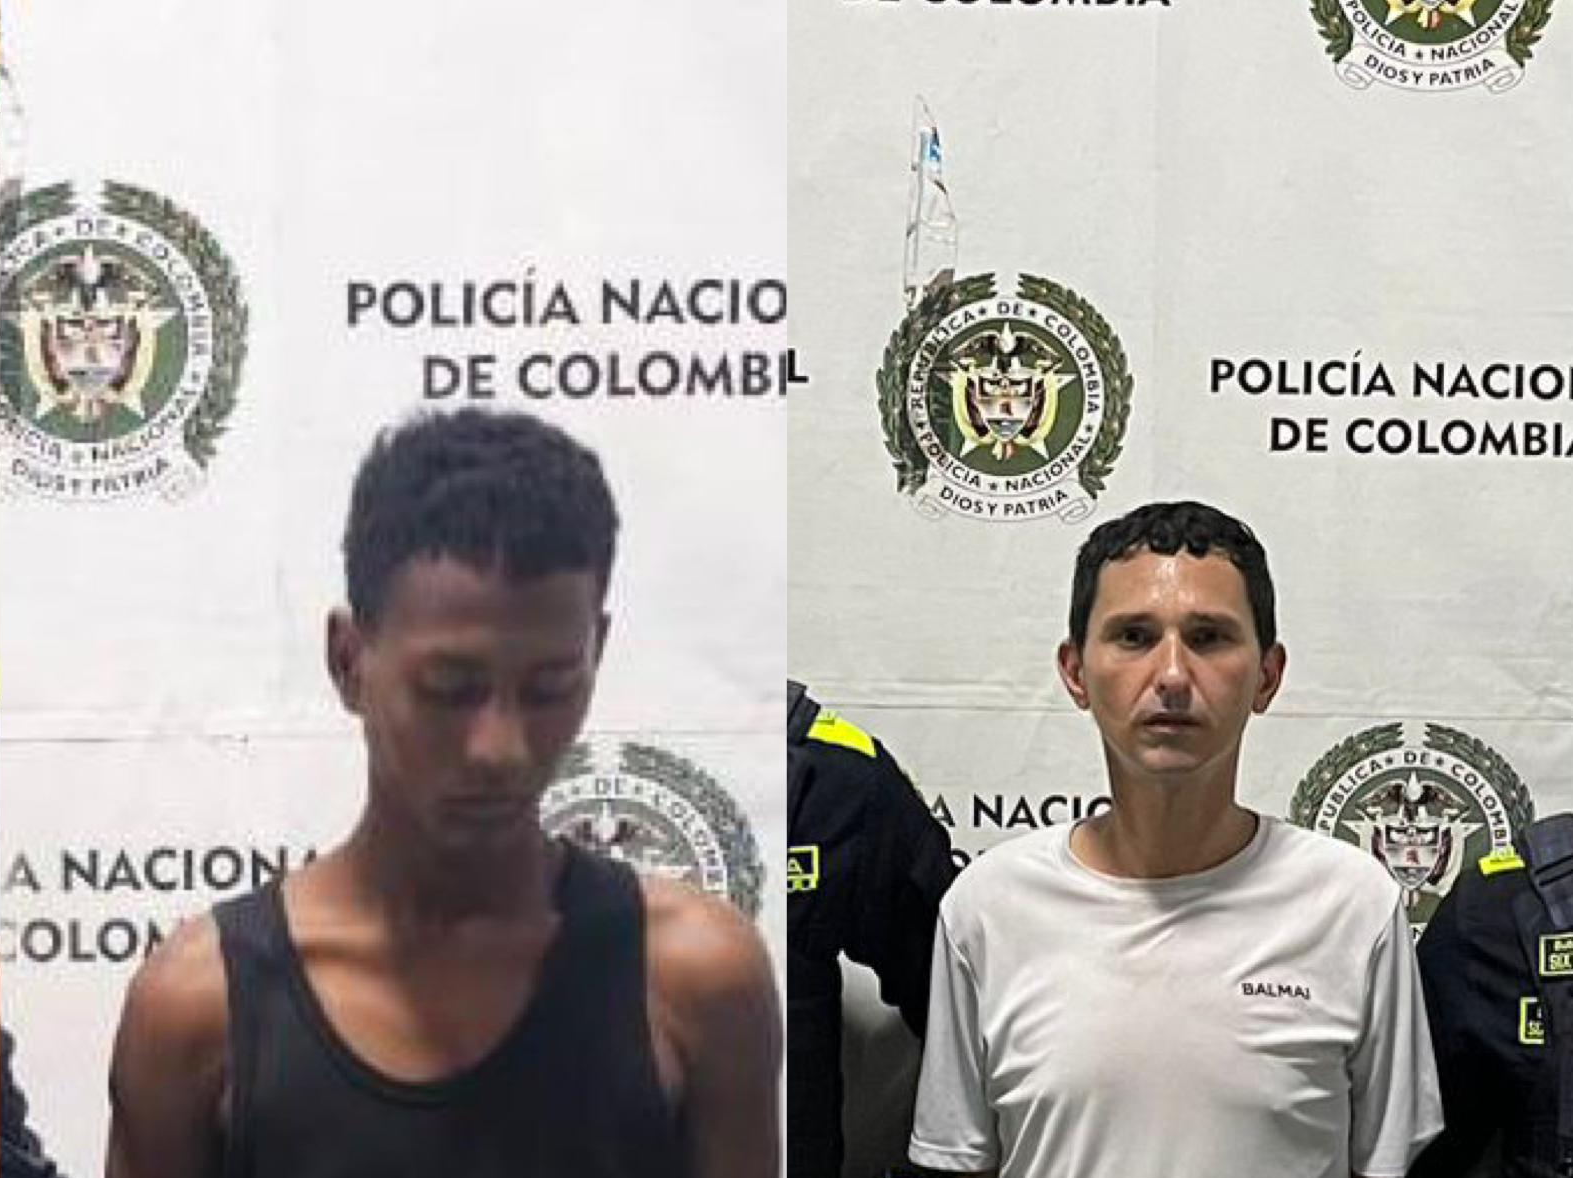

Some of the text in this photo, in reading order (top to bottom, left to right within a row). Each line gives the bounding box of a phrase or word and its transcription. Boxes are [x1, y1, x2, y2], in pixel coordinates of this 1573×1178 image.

[1430, 1, 1519, 61] NACIONAL
[1364, 54, 1496, 87] DIOS Y PATRIA
[347, 268, 787, 328] POLICÍA NACIO
[423, 350, 787, 400] DE COLOMBI
[996, 301, 1024, 316] DE
[1044, 313, 1101, 415] COLOMBIA
[1210, 350, 1573, 400] POLICÍA NACIO
[1270, 418, 1329, 452] DE
[1005, 433, 1092, 492] NACIONAL
[939, 486, 1069, 517] DIOS Y PATRIA
[1403, 751, 1431, 766] DE
